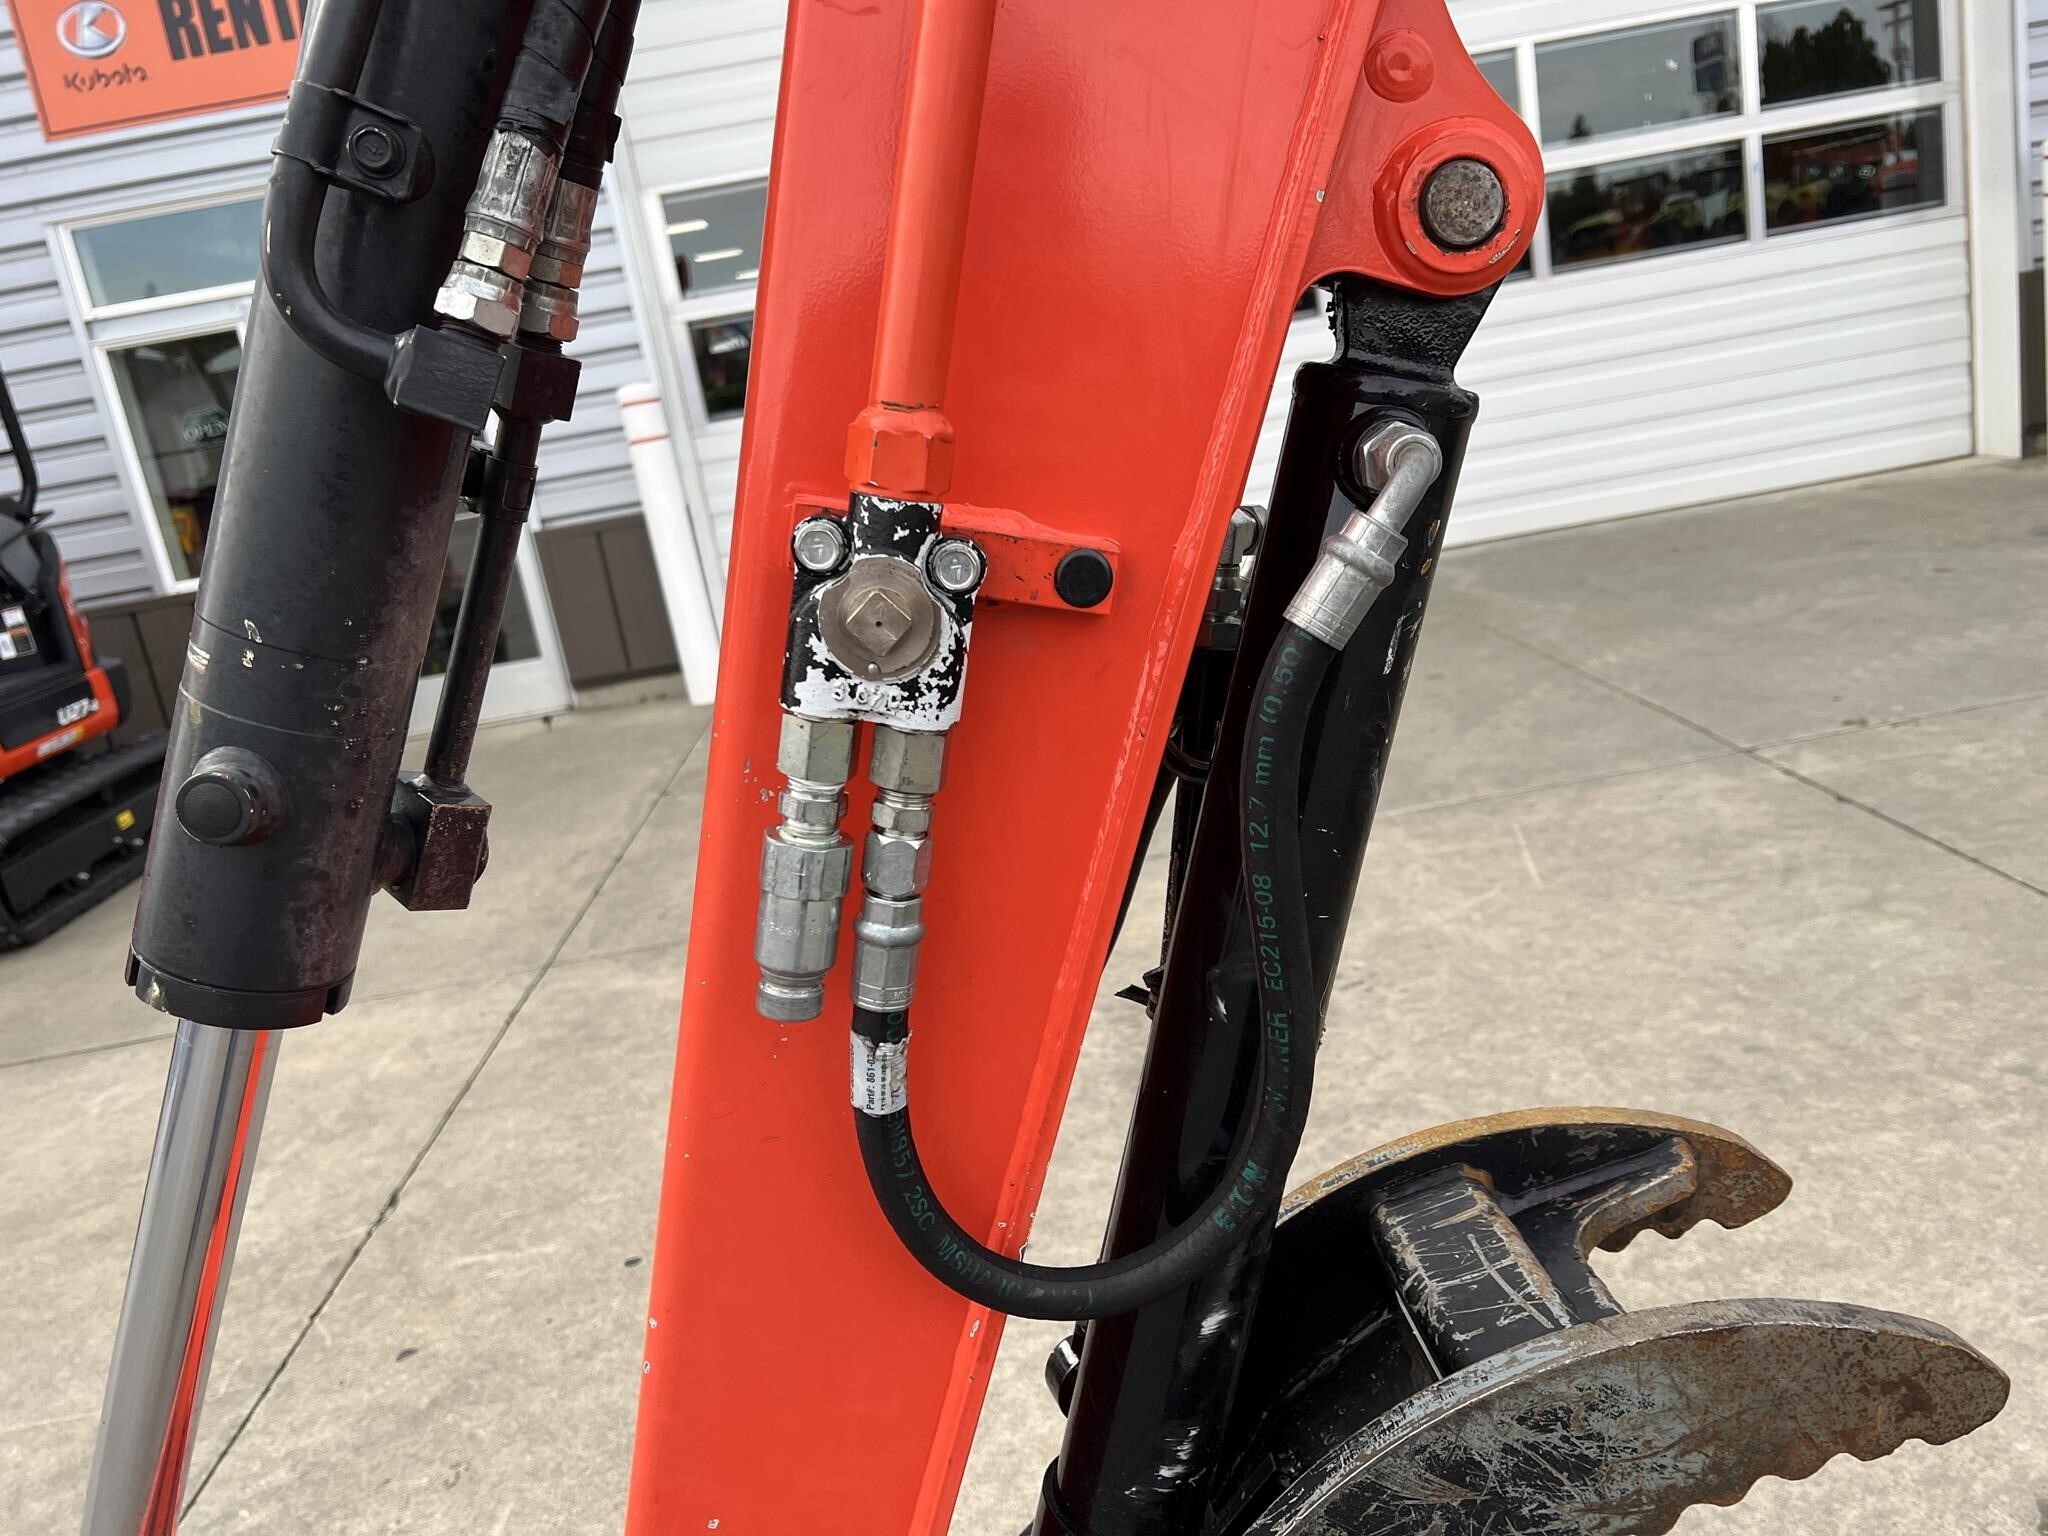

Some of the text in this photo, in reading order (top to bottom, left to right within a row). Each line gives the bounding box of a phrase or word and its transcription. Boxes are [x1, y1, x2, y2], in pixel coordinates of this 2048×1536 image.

[159, 0, 303, 61] RENT
[63, 62, 149, 92] Kubota
[183, 418, 229, 442] OPEN
[1254, 735, 1275, 786] mm
[1249, 795, 1270, 852] 12.7
[1252, 872, 1284, 992] EC215-08
[903, 1185, 936, 1232] 2SC
